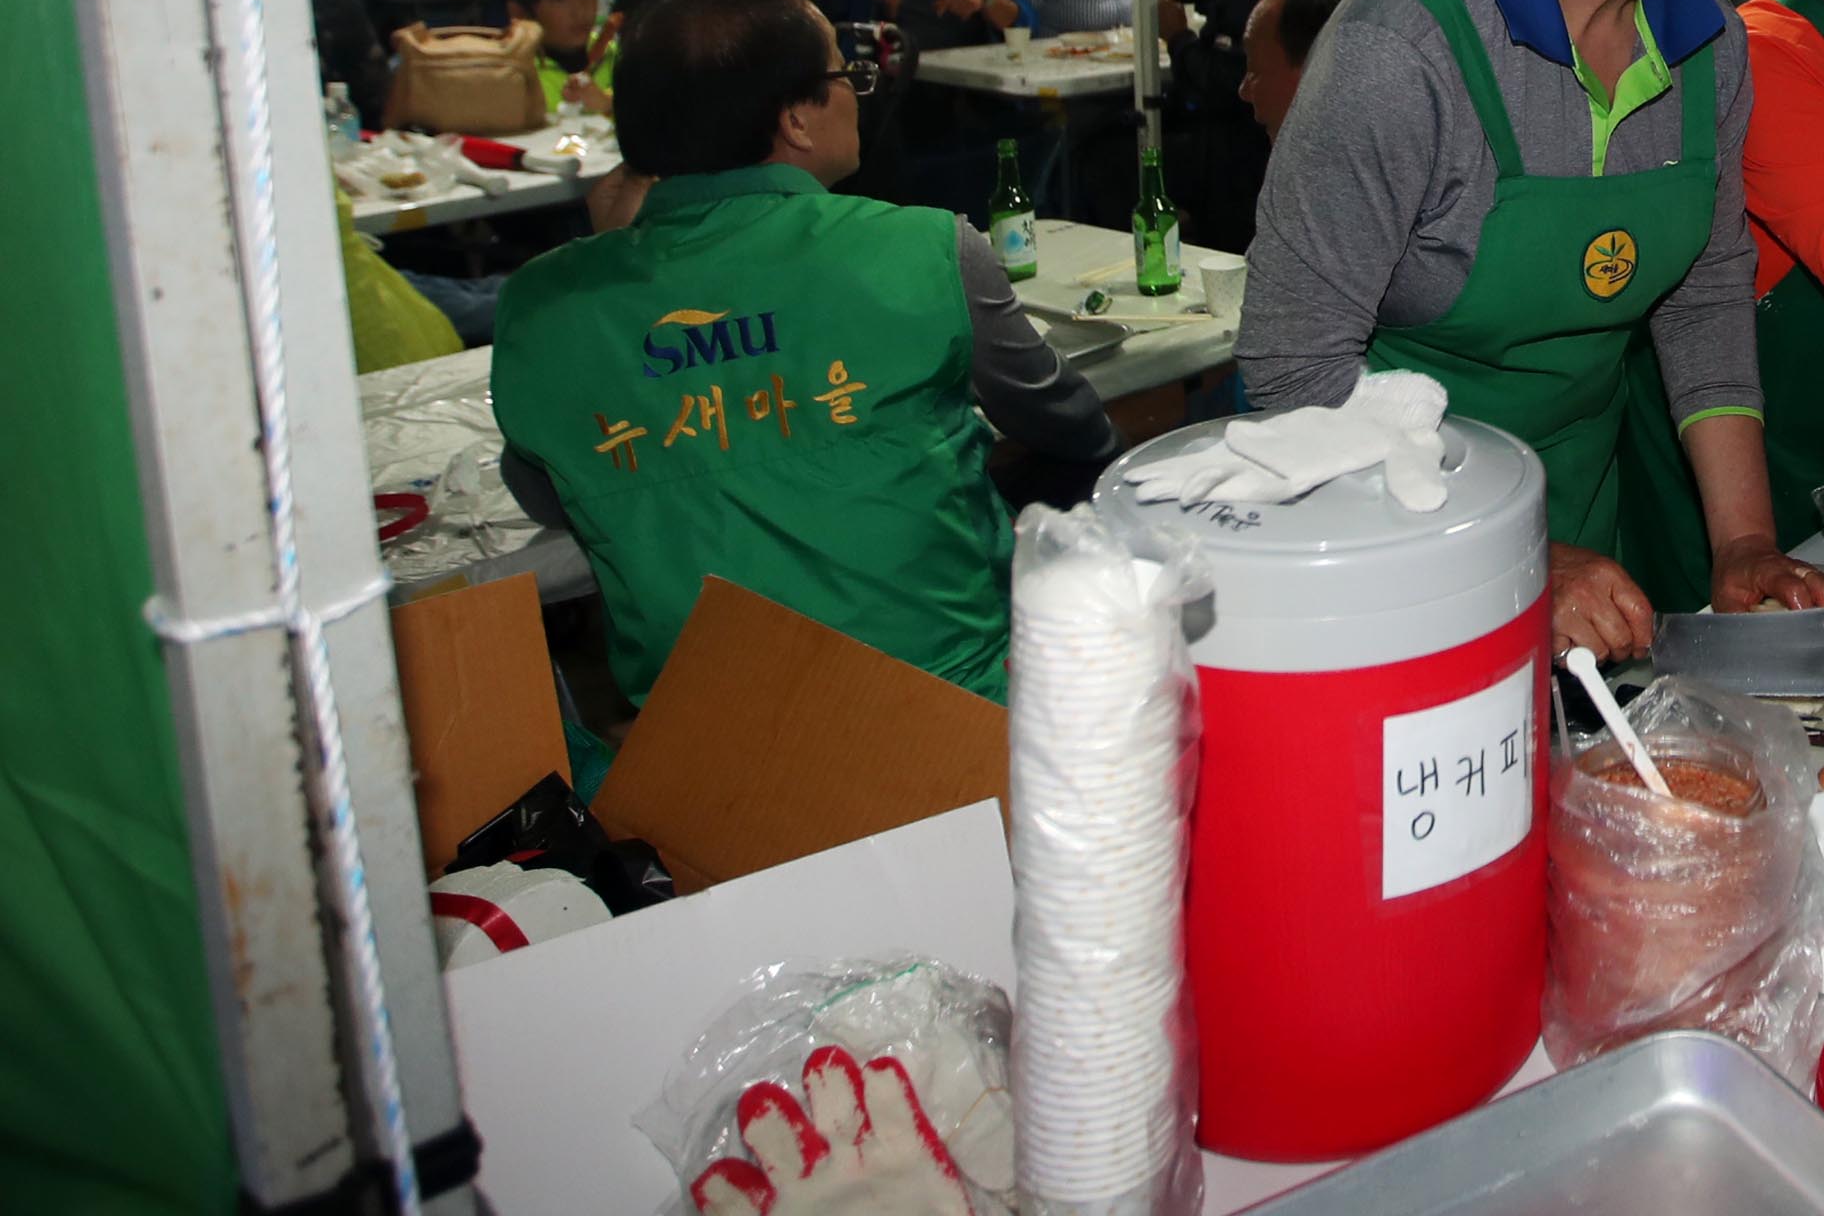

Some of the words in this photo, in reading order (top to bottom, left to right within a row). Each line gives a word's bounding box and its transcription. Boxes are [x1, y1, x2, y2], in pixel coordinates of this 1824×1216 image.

[643, 311, 781, 378] SMU
[593, 360, 868, 473] 뉴새마을
[1396, 719, 1527, 841] 냉커피
